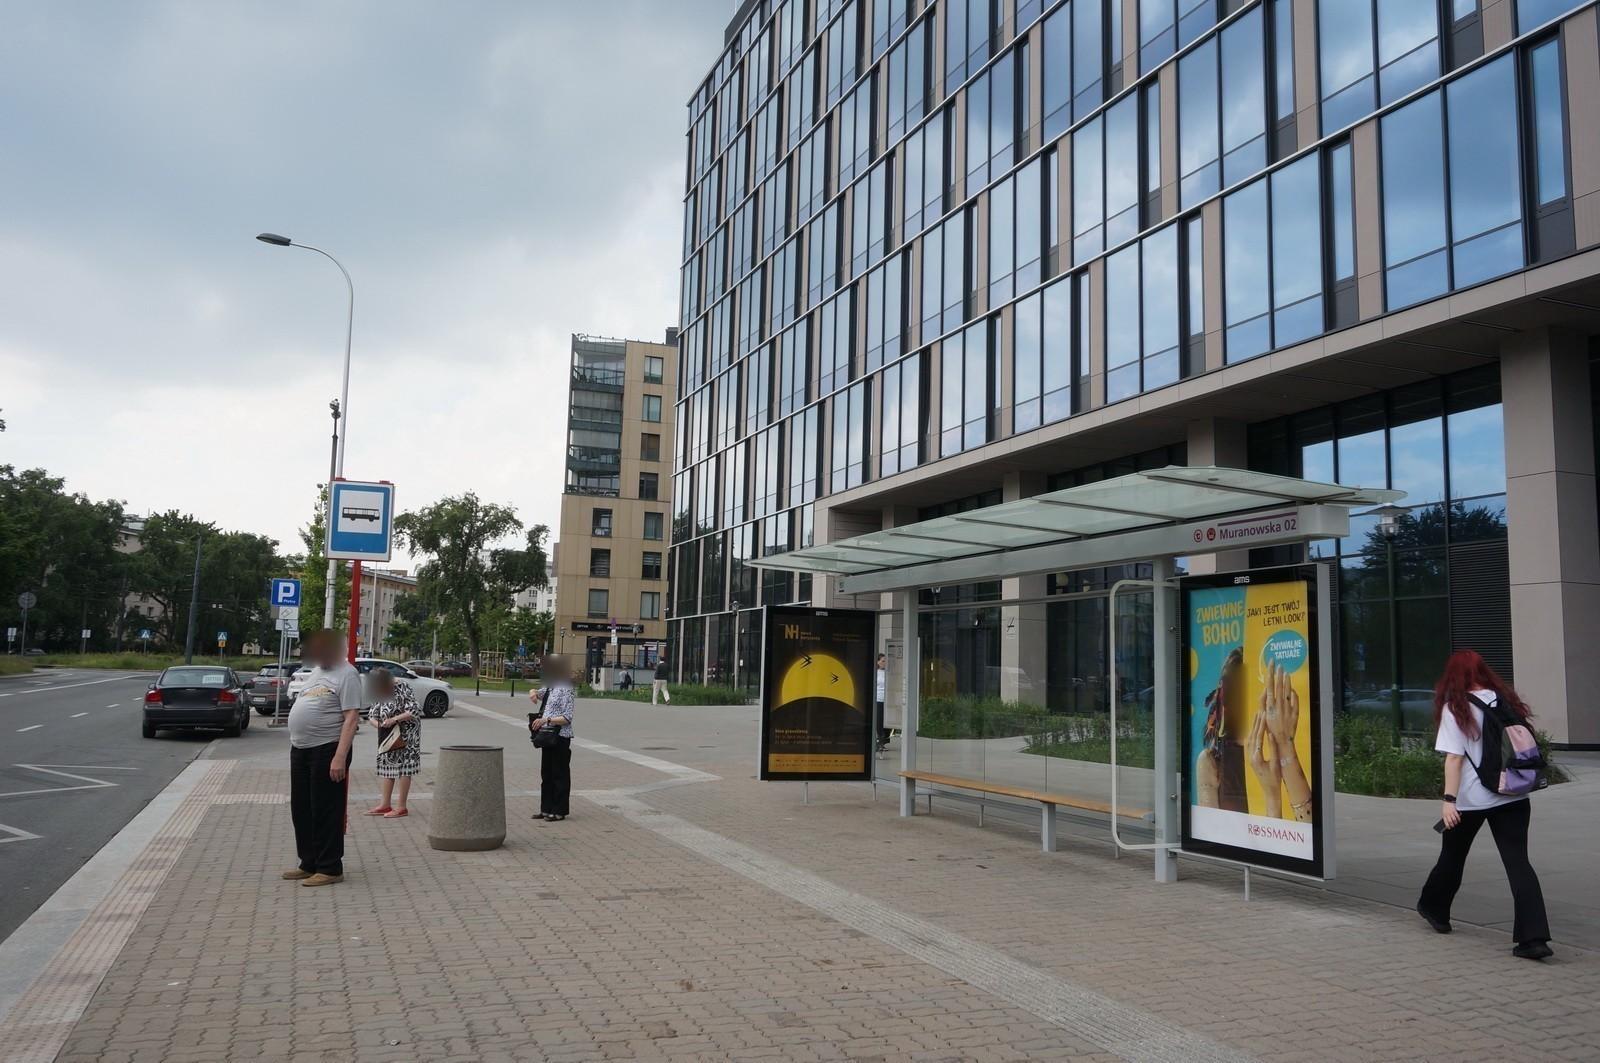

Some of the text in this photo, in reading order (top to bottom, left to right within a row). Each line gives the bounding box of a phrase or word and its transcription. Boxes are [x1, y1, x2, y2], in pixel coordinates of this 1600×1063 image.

[1219, 518, 1297, 541] Muranowska 02
[1233, 575, 1250, 585] ams
[277, 582, 295, 603] P
[1196, 601, 1243, 624] ZWIEWNE
[1247, 600, 1300, 618] JAKI JEST TWÓJ
[1263, 611, 1306, 627] LETNI LOOK?
[784, 624, 799, 640] NH
[1202, 621, 1241, 646] BOHO
[1247, 823, 1305, 843] ROSSMANN
